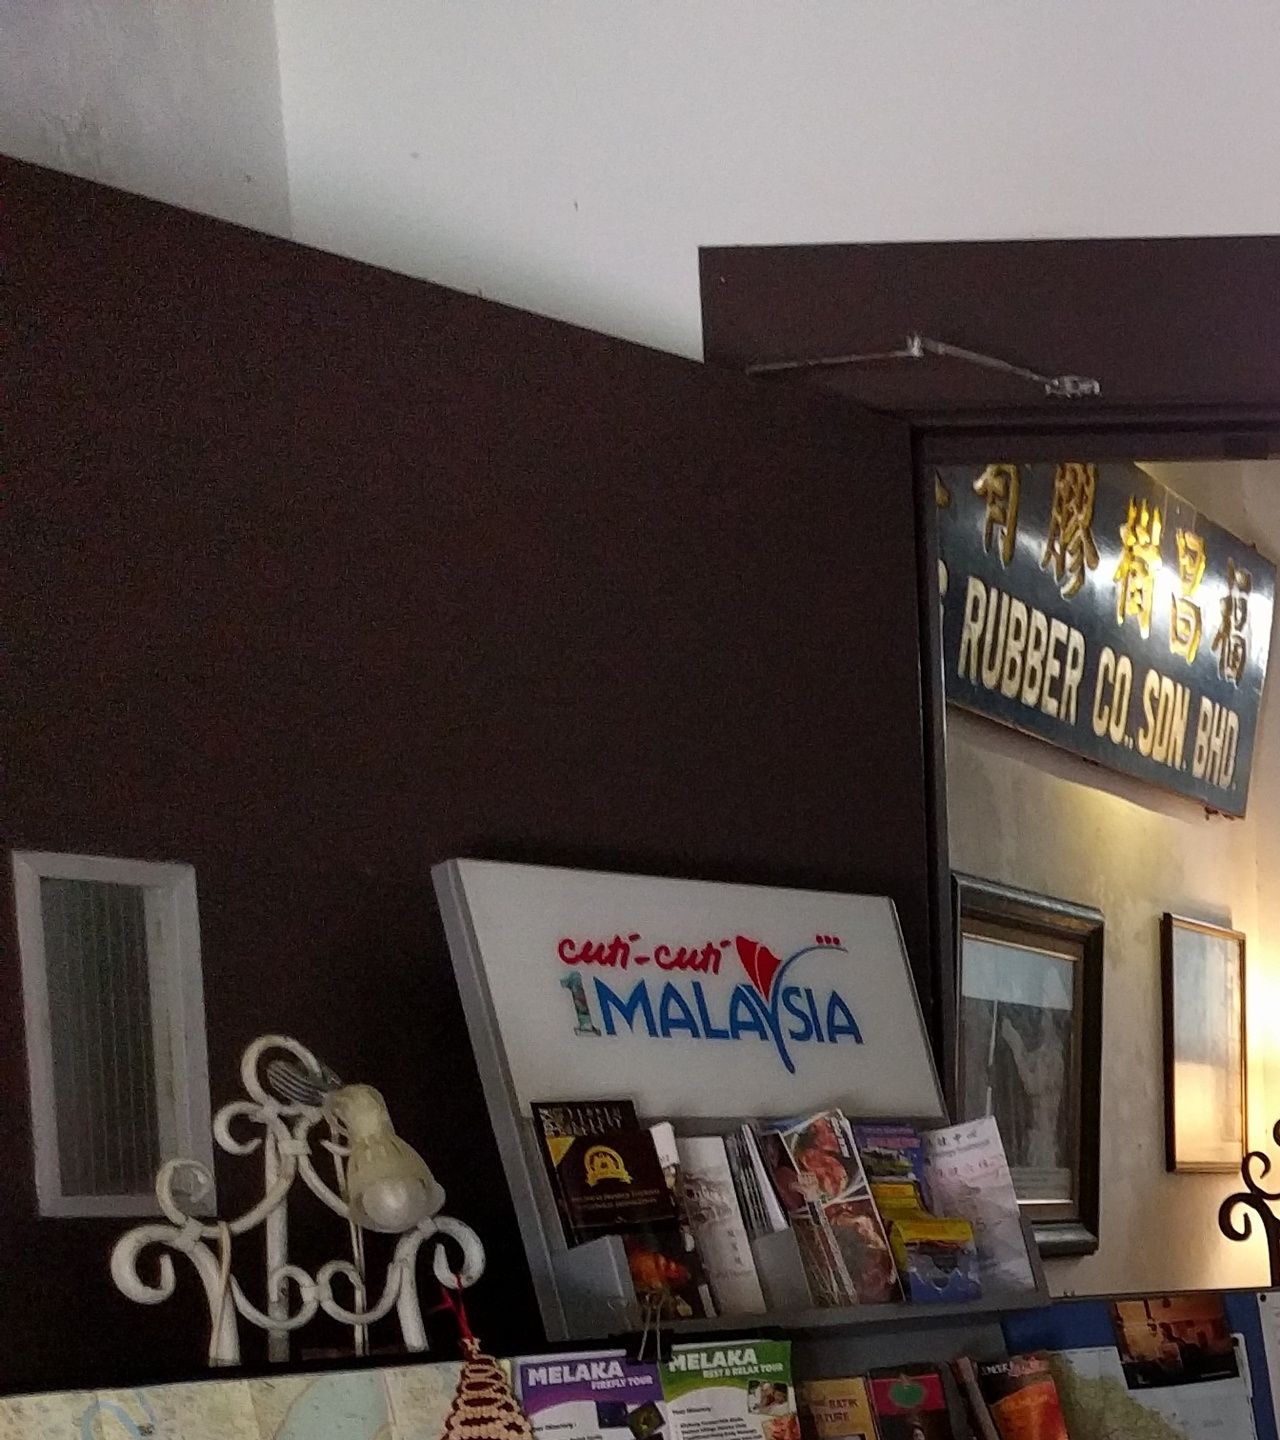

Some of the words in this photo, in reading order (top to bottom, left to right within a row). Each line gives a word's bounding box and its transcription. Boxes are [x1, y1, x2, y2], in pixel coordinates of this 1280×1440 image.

[958, 576, 1086, 726] RUBBER
[528, 1360, 624, 1386] MELAKA
[668, 1348, 757, 1372] MELAKA
